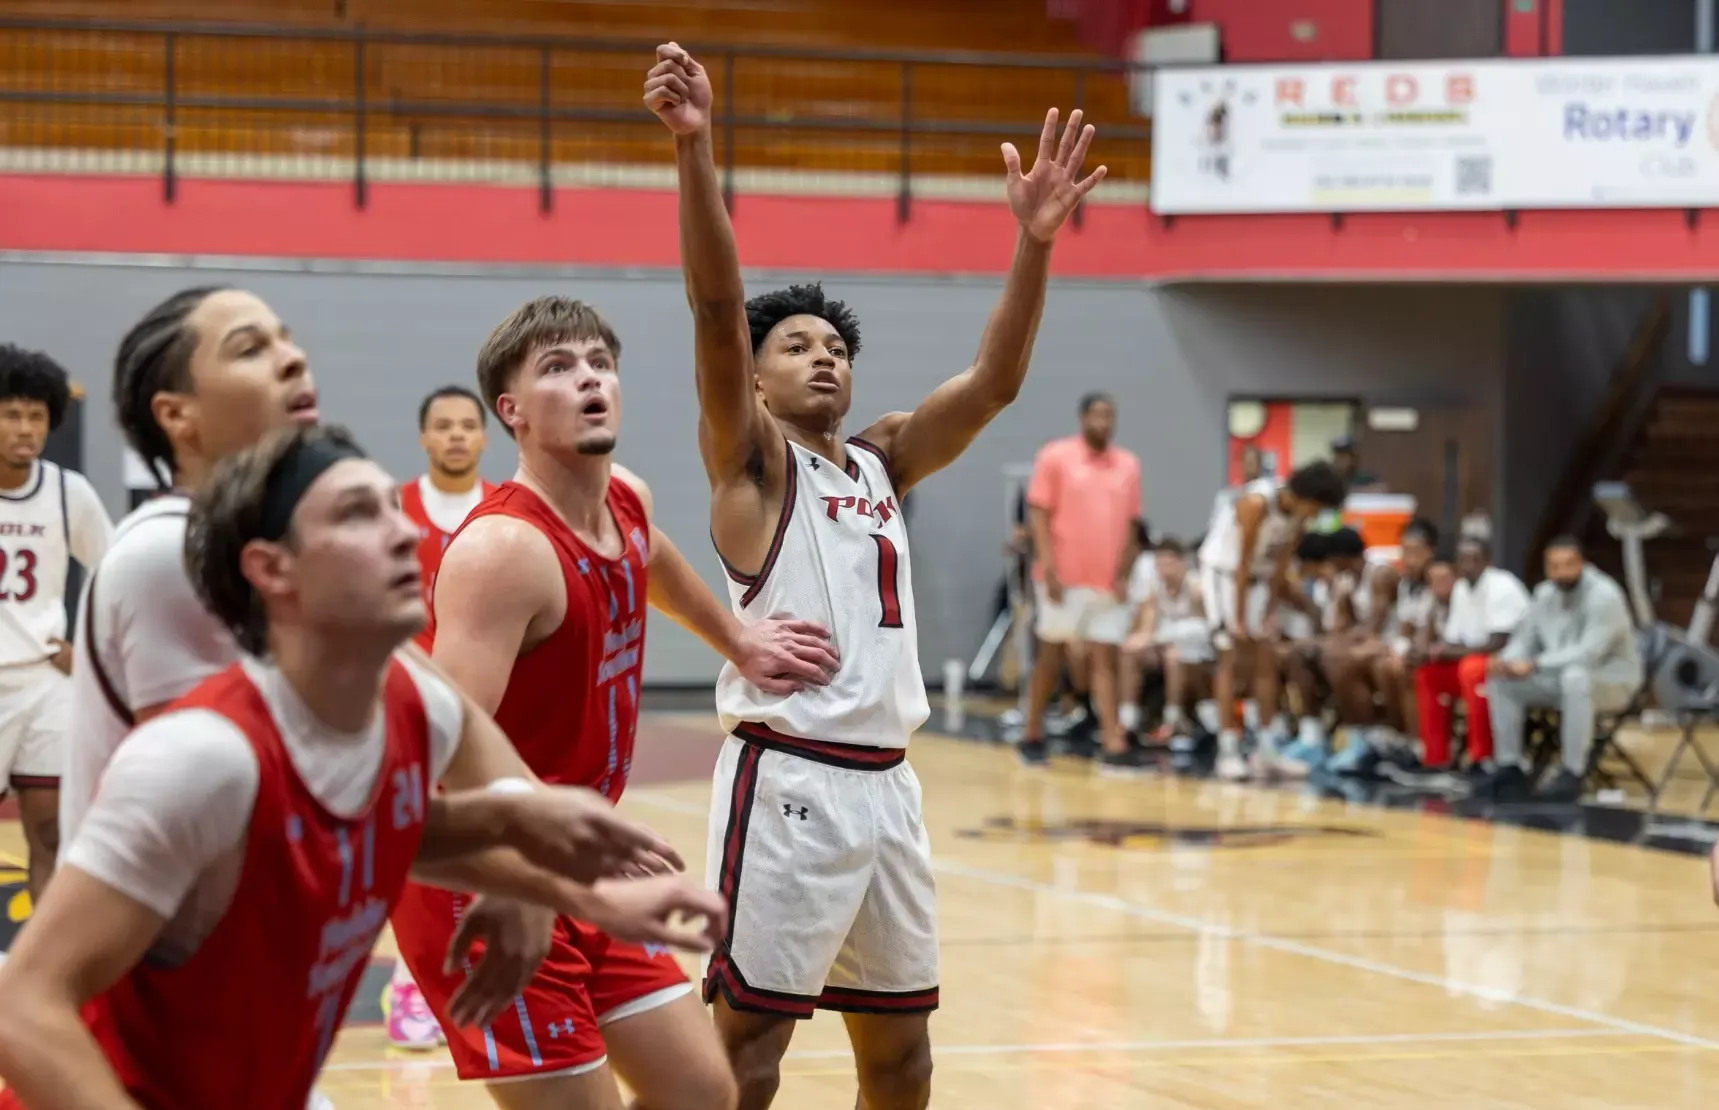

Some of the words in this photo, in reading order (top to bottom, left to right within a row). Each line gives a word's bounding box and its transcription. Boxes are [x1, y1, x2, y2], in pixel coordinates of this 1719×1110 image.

[1563, 101, 1697, 149] Rotary
[819, 496, 898, 530] POK
[868, 533, 904, 629] 1
